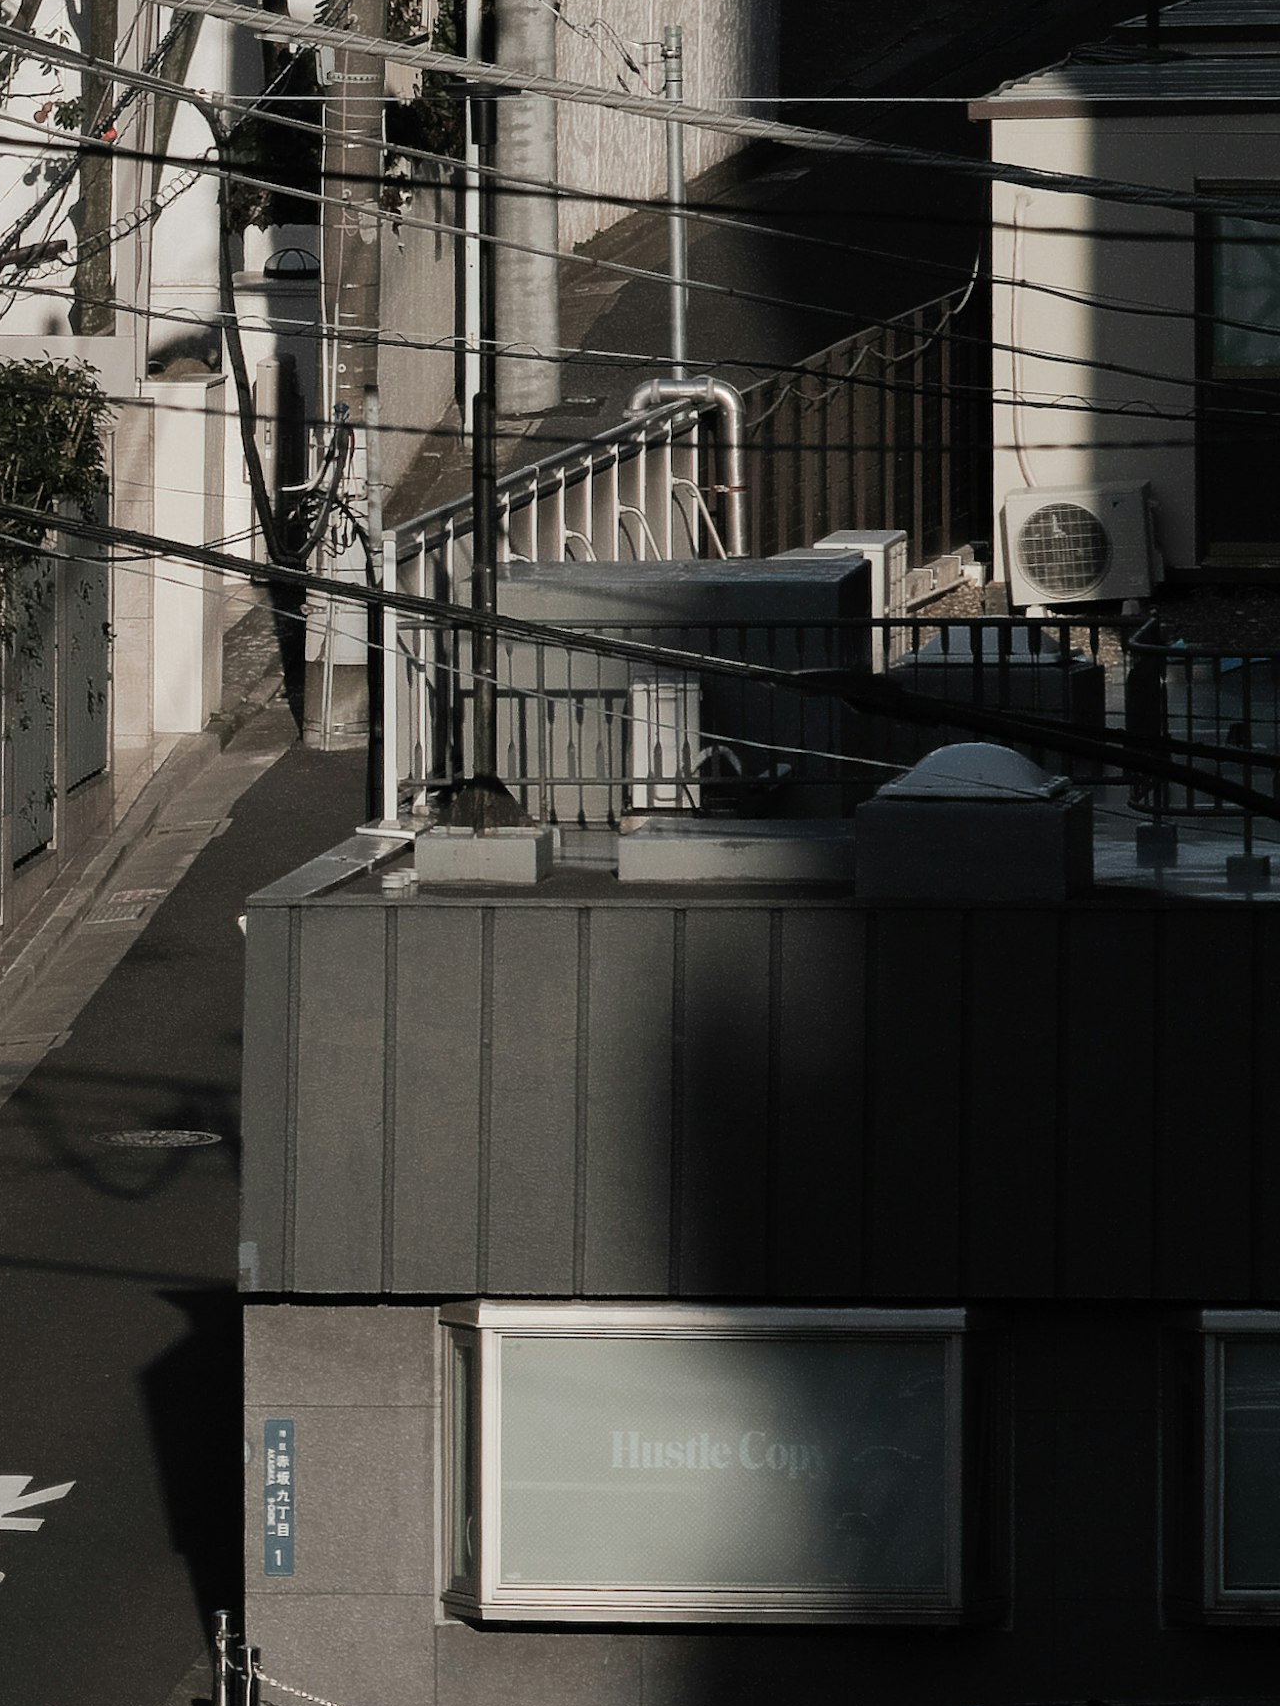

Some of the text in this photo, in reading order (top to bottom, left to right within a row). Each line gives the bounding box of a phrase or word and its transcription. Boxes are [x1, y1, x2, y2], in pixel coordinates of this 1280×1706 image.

[611, 1431, 733, 1470] Hustle
[276, 1454, 290, 1537] 赤坂九丁目
[274, 1549, 282, 1567] 1
